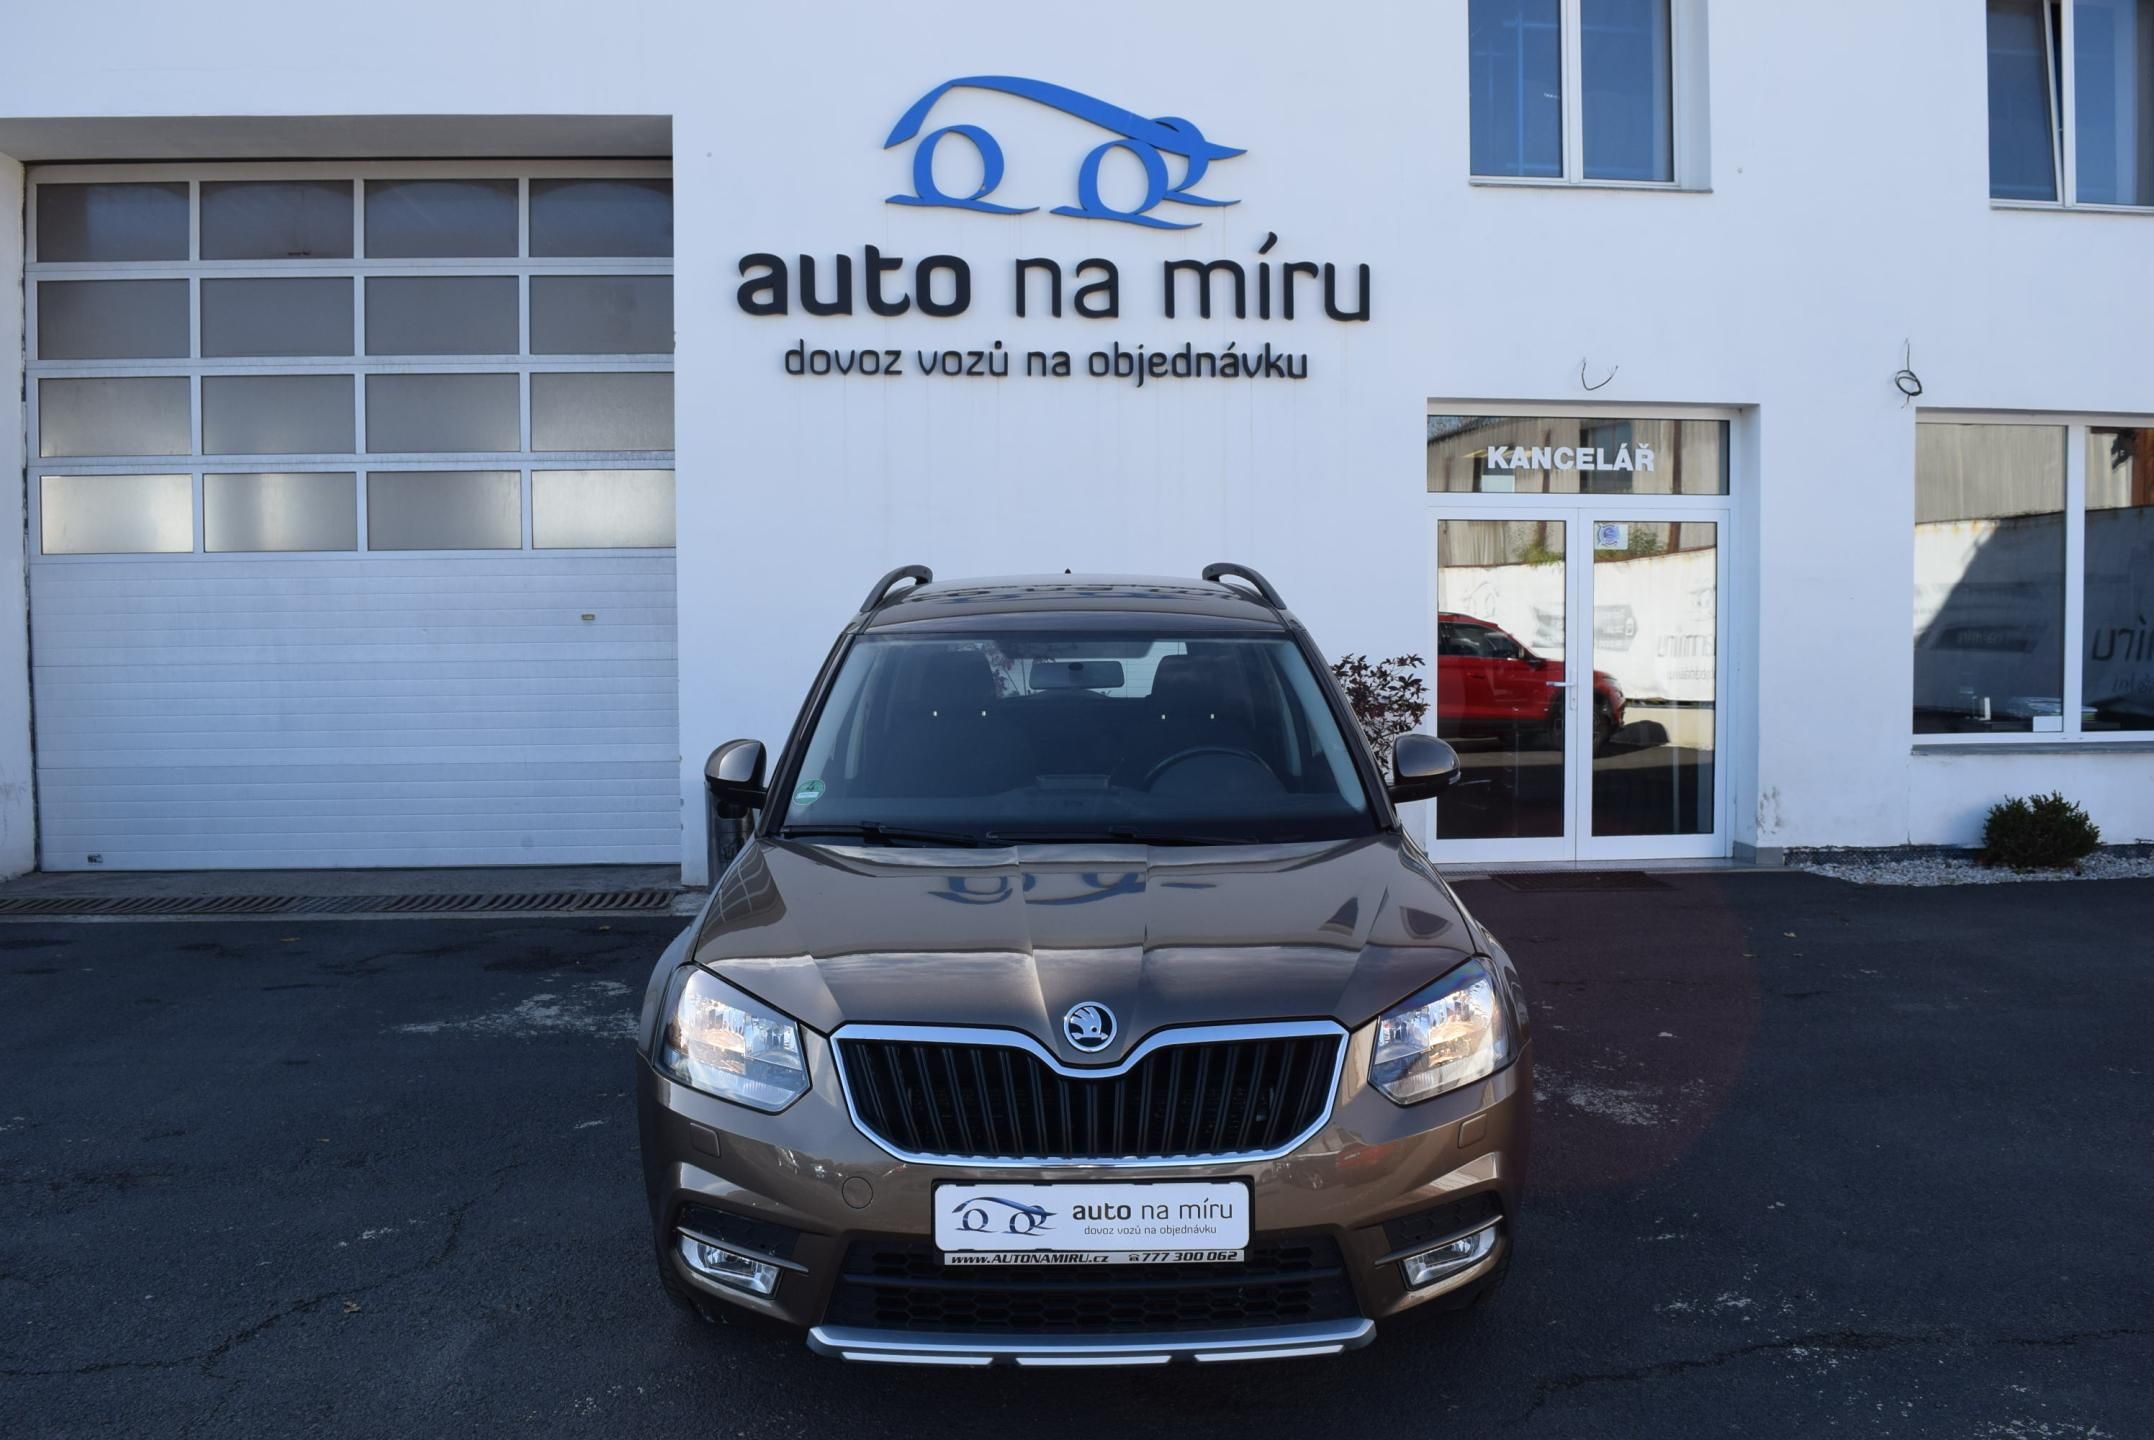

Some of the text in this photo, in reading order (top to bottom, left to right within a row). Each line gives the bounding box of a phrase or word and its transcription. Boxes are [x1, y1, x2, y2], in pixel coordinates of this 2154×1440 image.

[736, 230, 1371, 322] auto na míru
[784, 339, 1309, 389] dovoz vozů na objednávku
[1487, 442, 1656, 473] KANCELÁŘ
[1072, 1198, 1233, 1221] auto na míru
[1084, 1225, 1114, 1236] dovoz
[1144, 1226, 1157, 1235] na
[1159, 1224, 1218, 1237] objednávku
[951, 1251, 1238, 1264] www.AUTONAMIRU.cz 777 300 062
